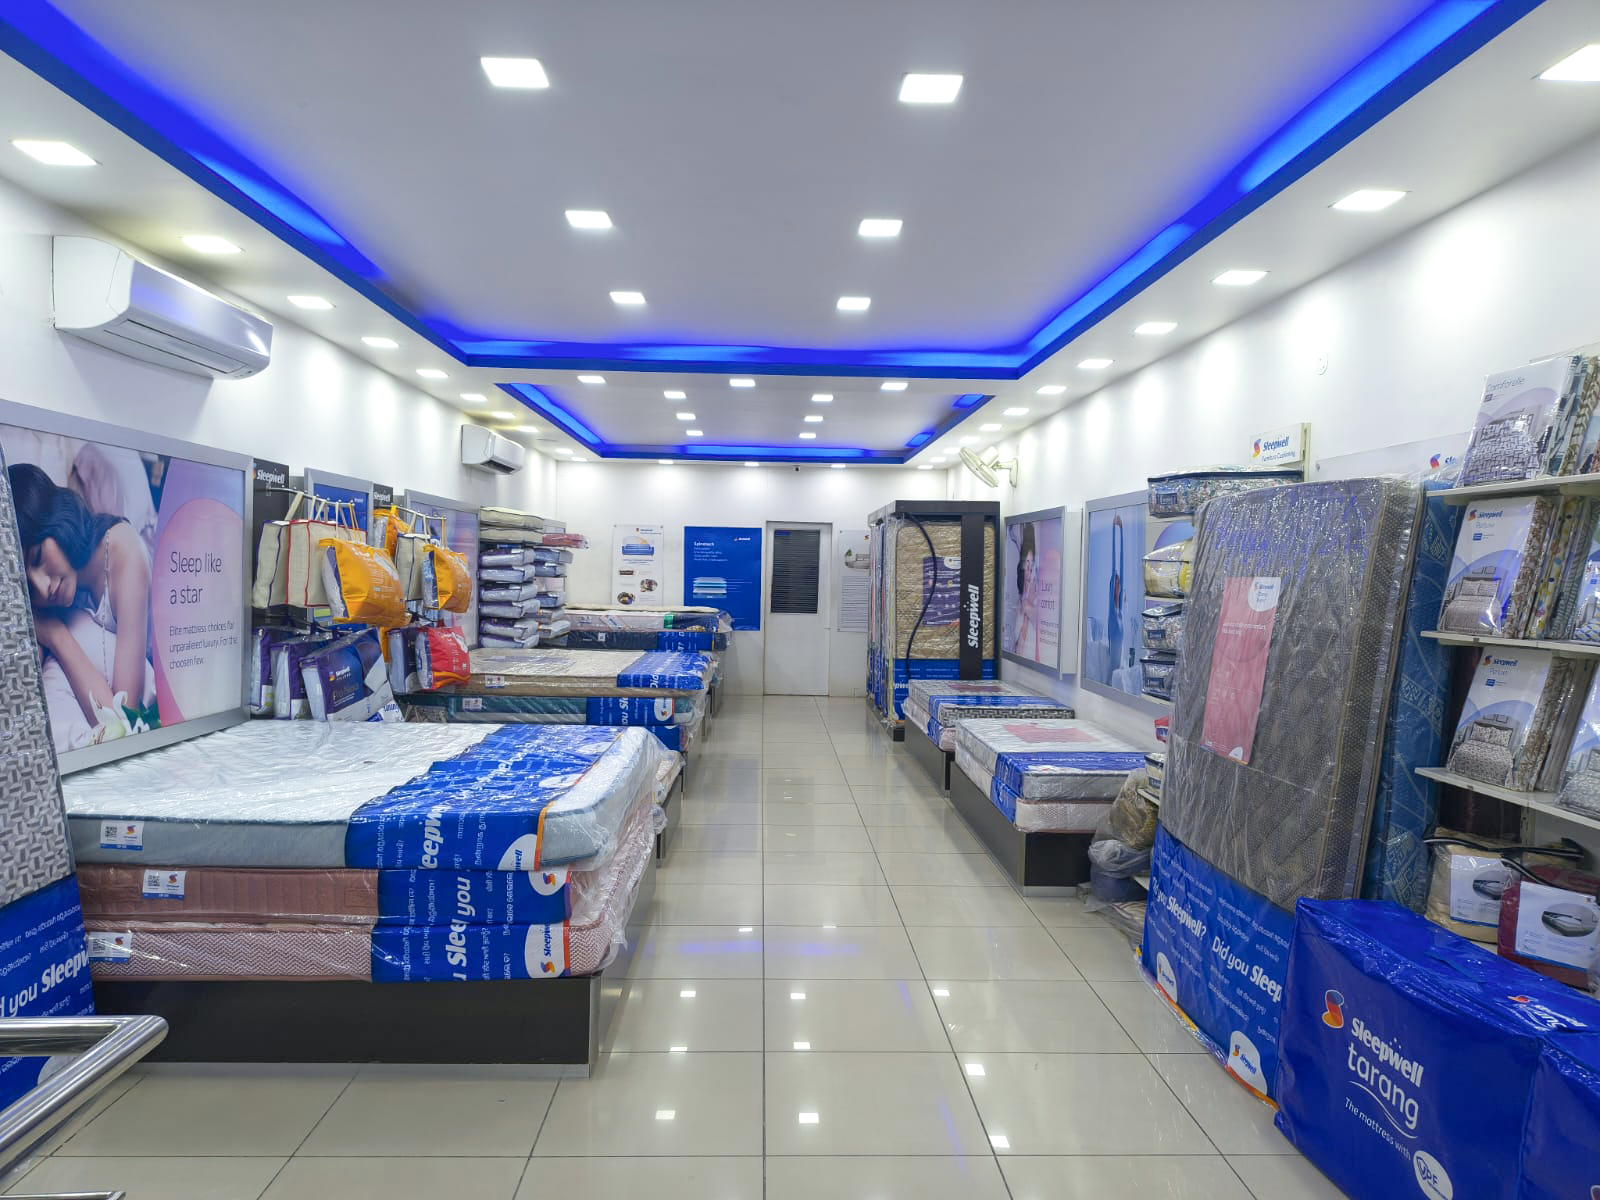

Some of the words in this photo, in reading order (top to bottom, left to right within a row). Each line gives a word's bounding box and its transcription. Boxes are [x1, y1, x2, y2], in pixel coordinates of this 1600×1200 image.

[257, 468, 286, 484] Sleepwell
[170, 551, 202, 577] Sleep
[204, 552, 222, 573] like
[170, 589, 177, 605] a
[180, 585, 204, 604] star
[967, 584, 980, 648] Sleepwell
[456, 876, 476, 916] you
[1166, 896, 1207, 940] Sleepwell?
[1211, 936, 1228, 961] Did
[1226, 954, 1250, 976] you
[9, 982, 38, 1017] you
[1240, 1054, 1256, 1075] Sleepwell
[1352, 1017, 1424, 1088] Sleepwell
[1348, 1042, 1420, 1129] tarang
[1345, 1096, 1358, 1115] The
[1359, 1110, 1394, 1145] mattress
[1394, 1140, 1411, 1161] with
